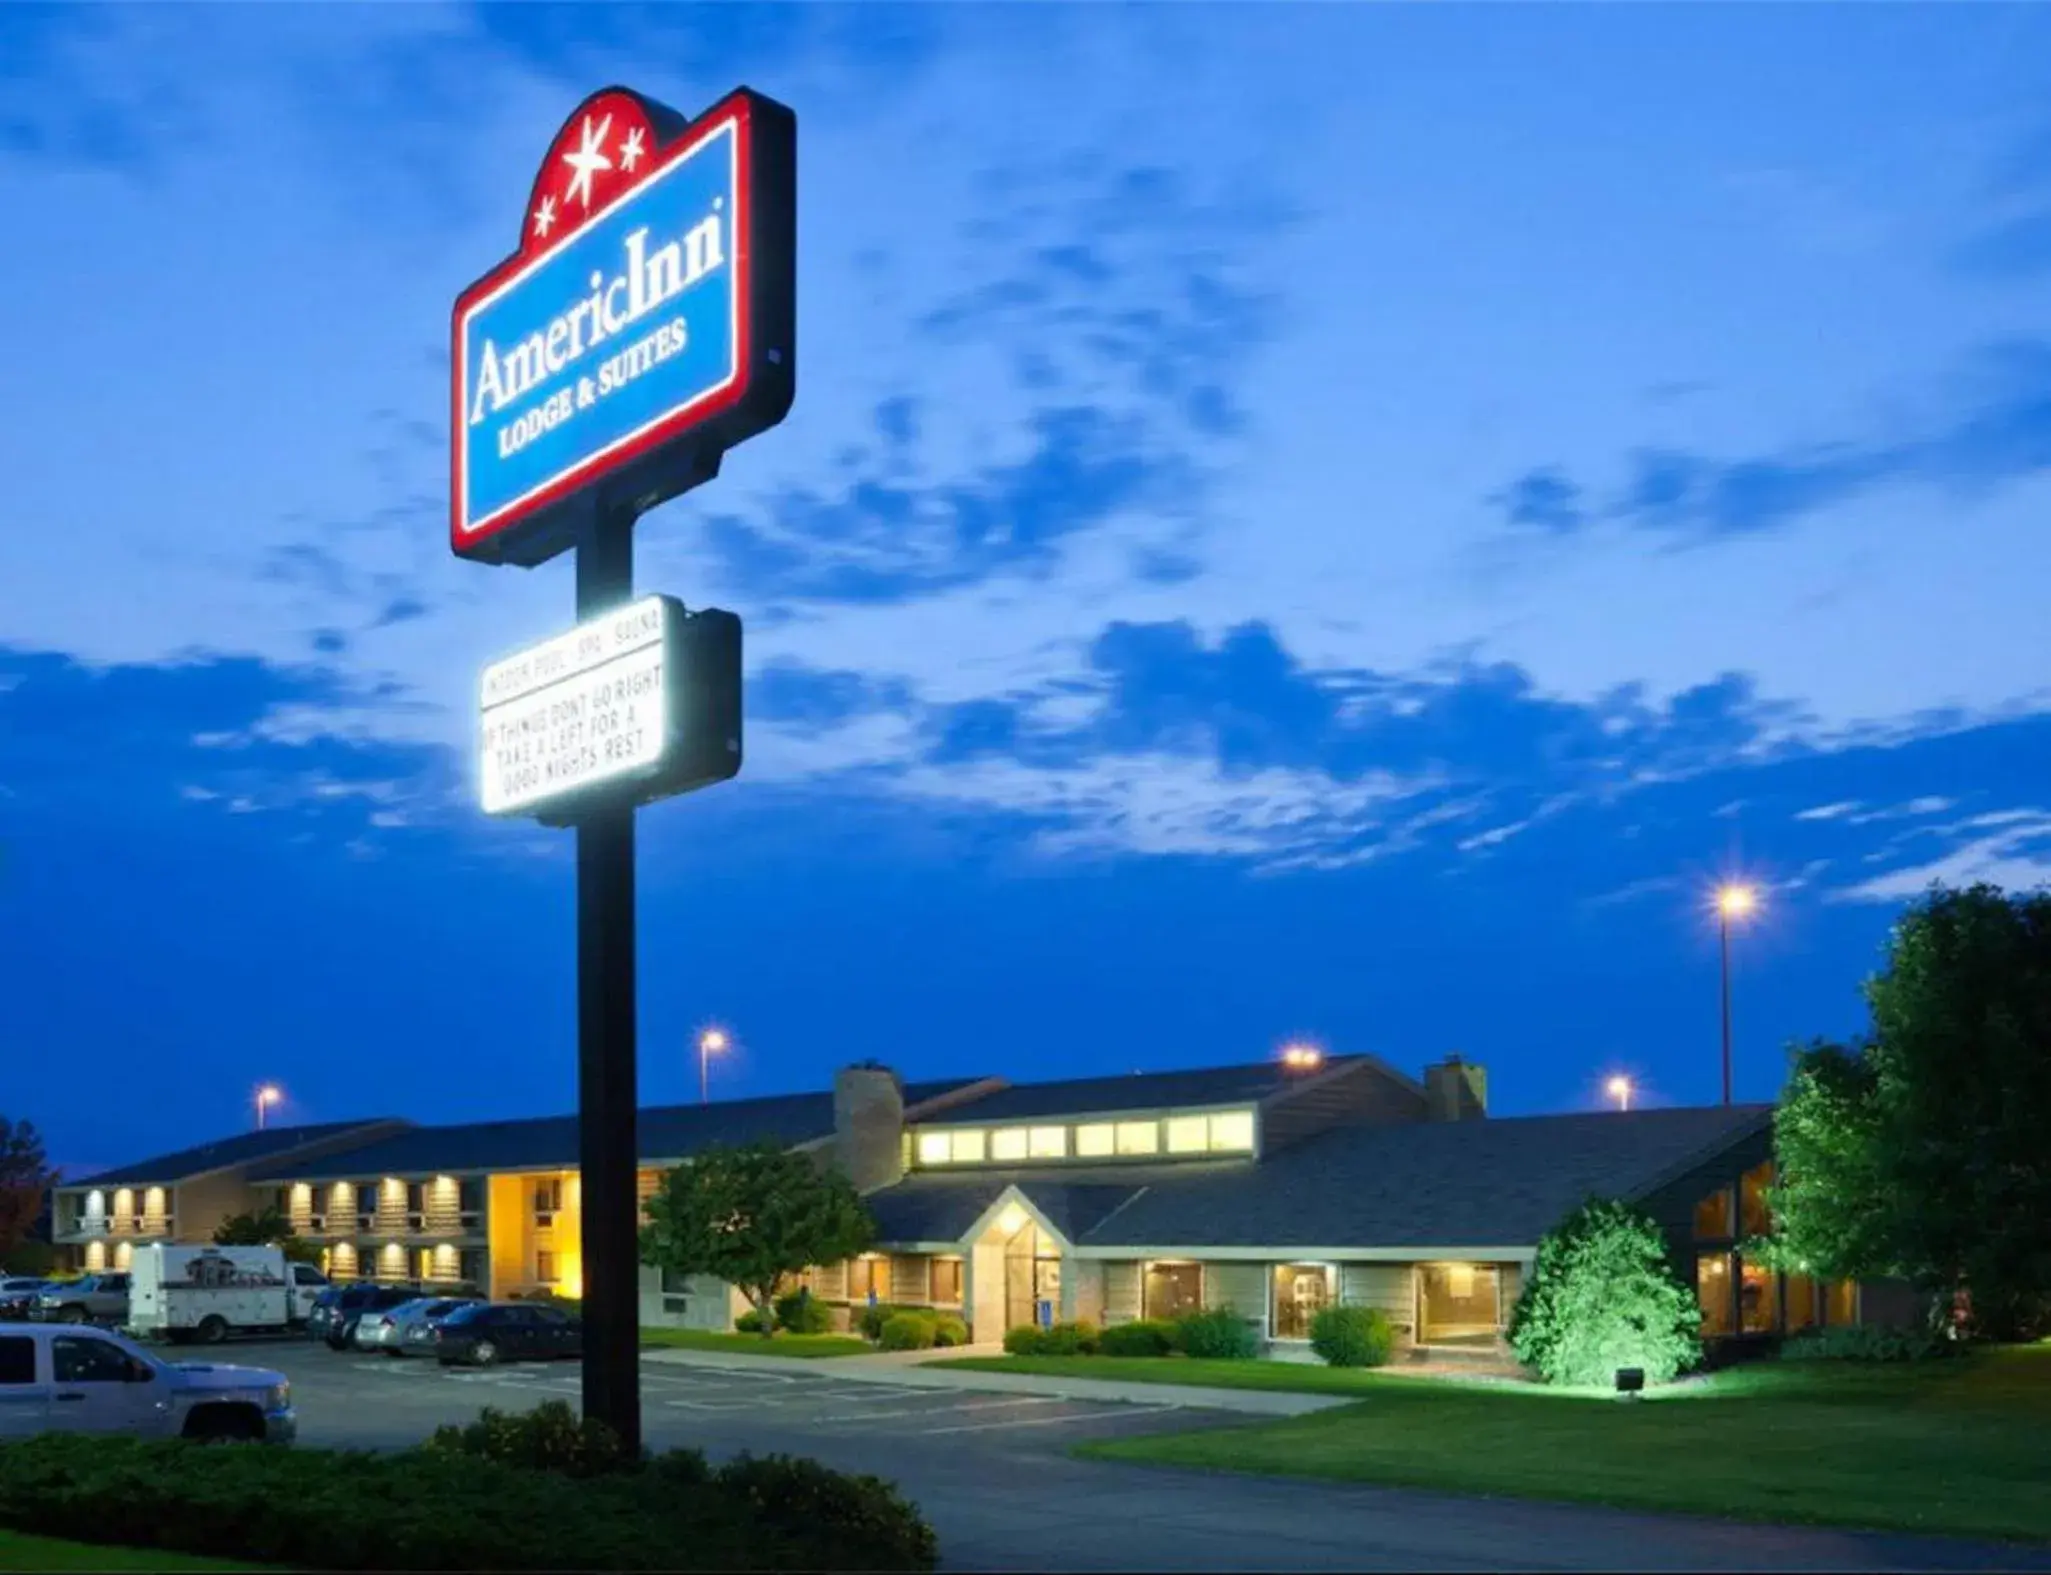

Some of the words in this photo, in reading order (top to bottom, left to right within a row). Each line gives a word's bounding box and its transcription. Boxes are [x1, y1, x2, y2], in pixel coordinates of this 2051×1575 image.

[470, 209, 724, 426] AmericInn
[498, 386, 573, 460] LODGE
[576, 376, 598, 410] &
[598, 316, 688, 397] SUITES
[615, 663, 661, 701] RIGHT
[550, 721, 584, 755] LEFT
[590, 708, 619, 738] FOR
[626, 703, 636, 730] A
[604, 728, 643, 765] REST
